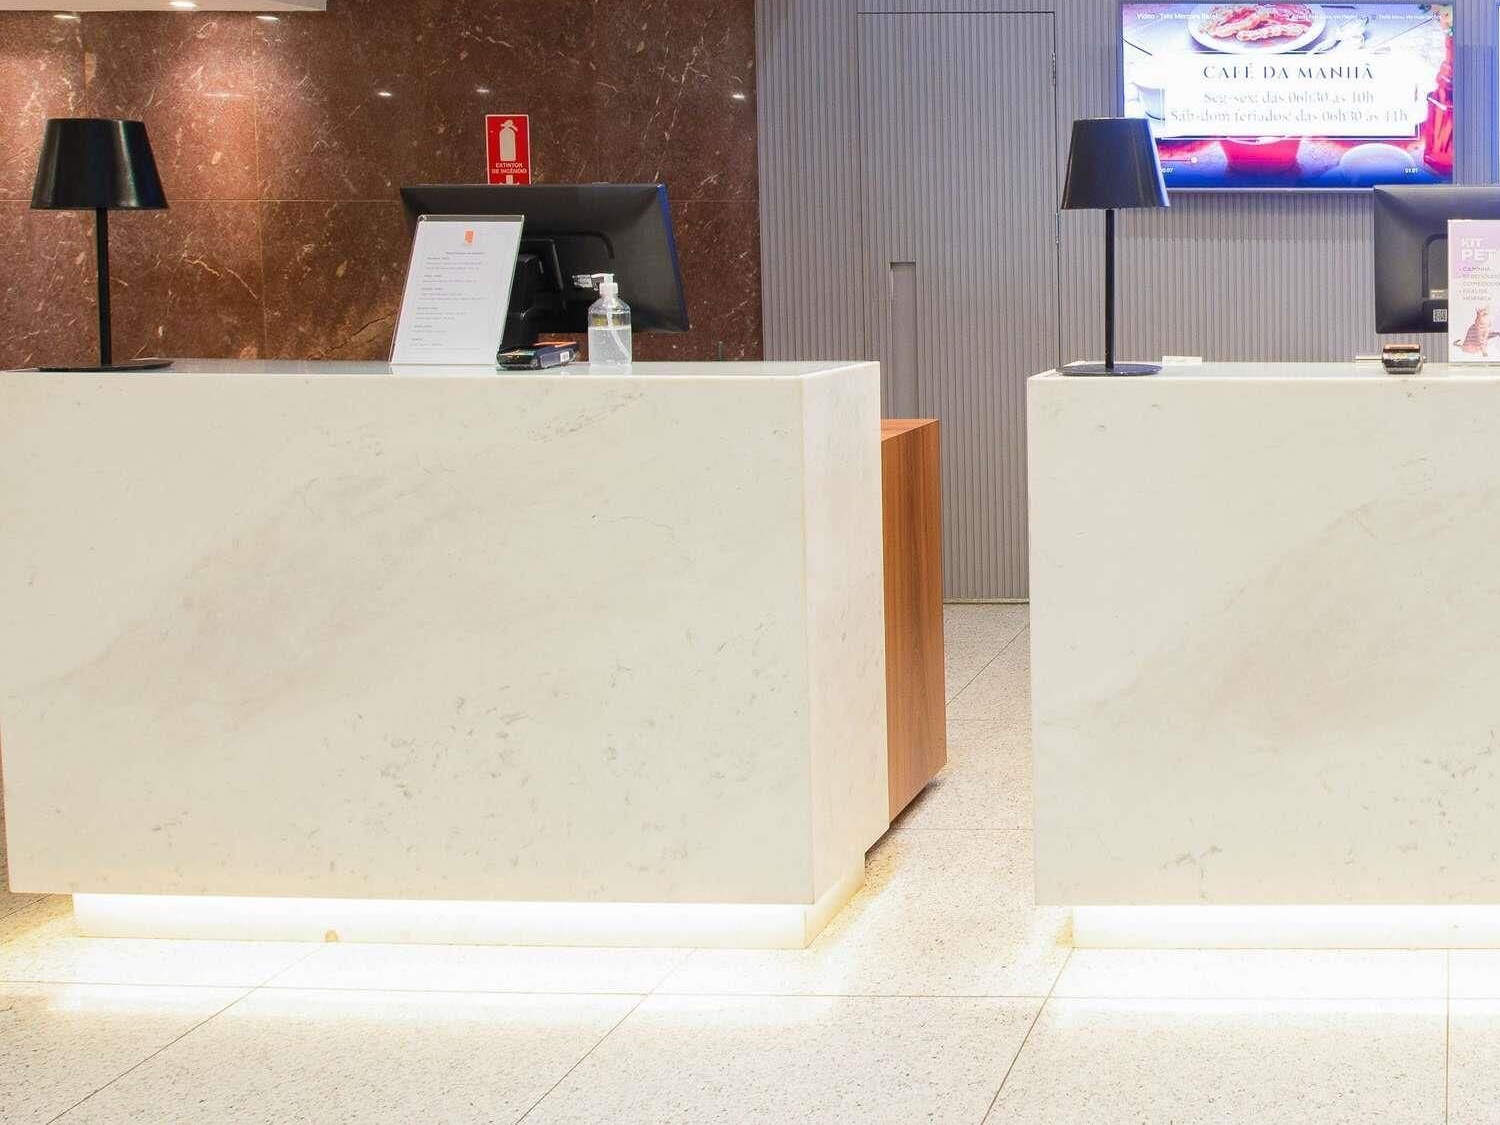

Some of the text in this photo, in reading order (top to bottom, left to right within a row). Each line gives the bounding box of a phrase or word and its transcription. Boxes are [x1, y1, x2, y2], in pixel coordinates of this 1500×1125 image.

[1203, 62, 1373, 79] CAFÉ DA MANHÃ
[1461, 248, 1497, 261] PET
